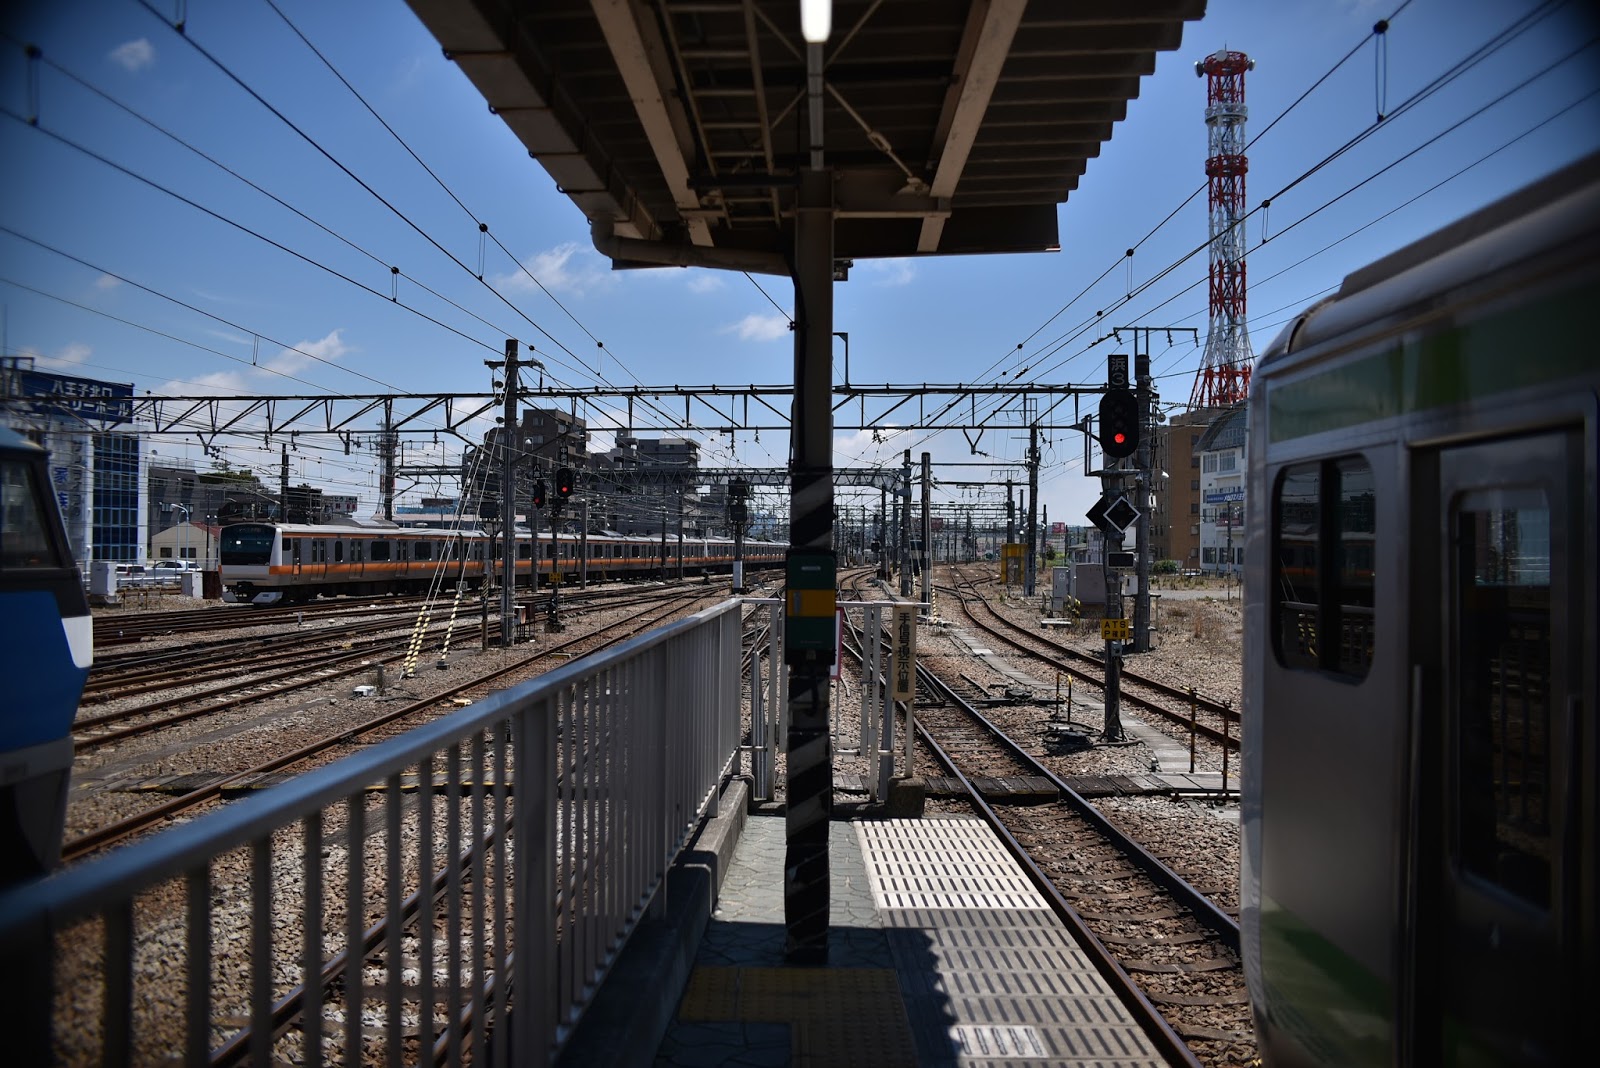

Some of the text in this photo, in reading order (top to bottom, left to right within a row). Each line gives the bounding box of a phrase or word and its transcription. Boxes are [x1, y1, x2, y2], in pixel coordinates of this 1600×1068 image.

[51, 379, 113, 398] 八王子北口
[1104, 621, 1126, 629] ATS
[897, 612, 911, 693] 手信号現示位置
